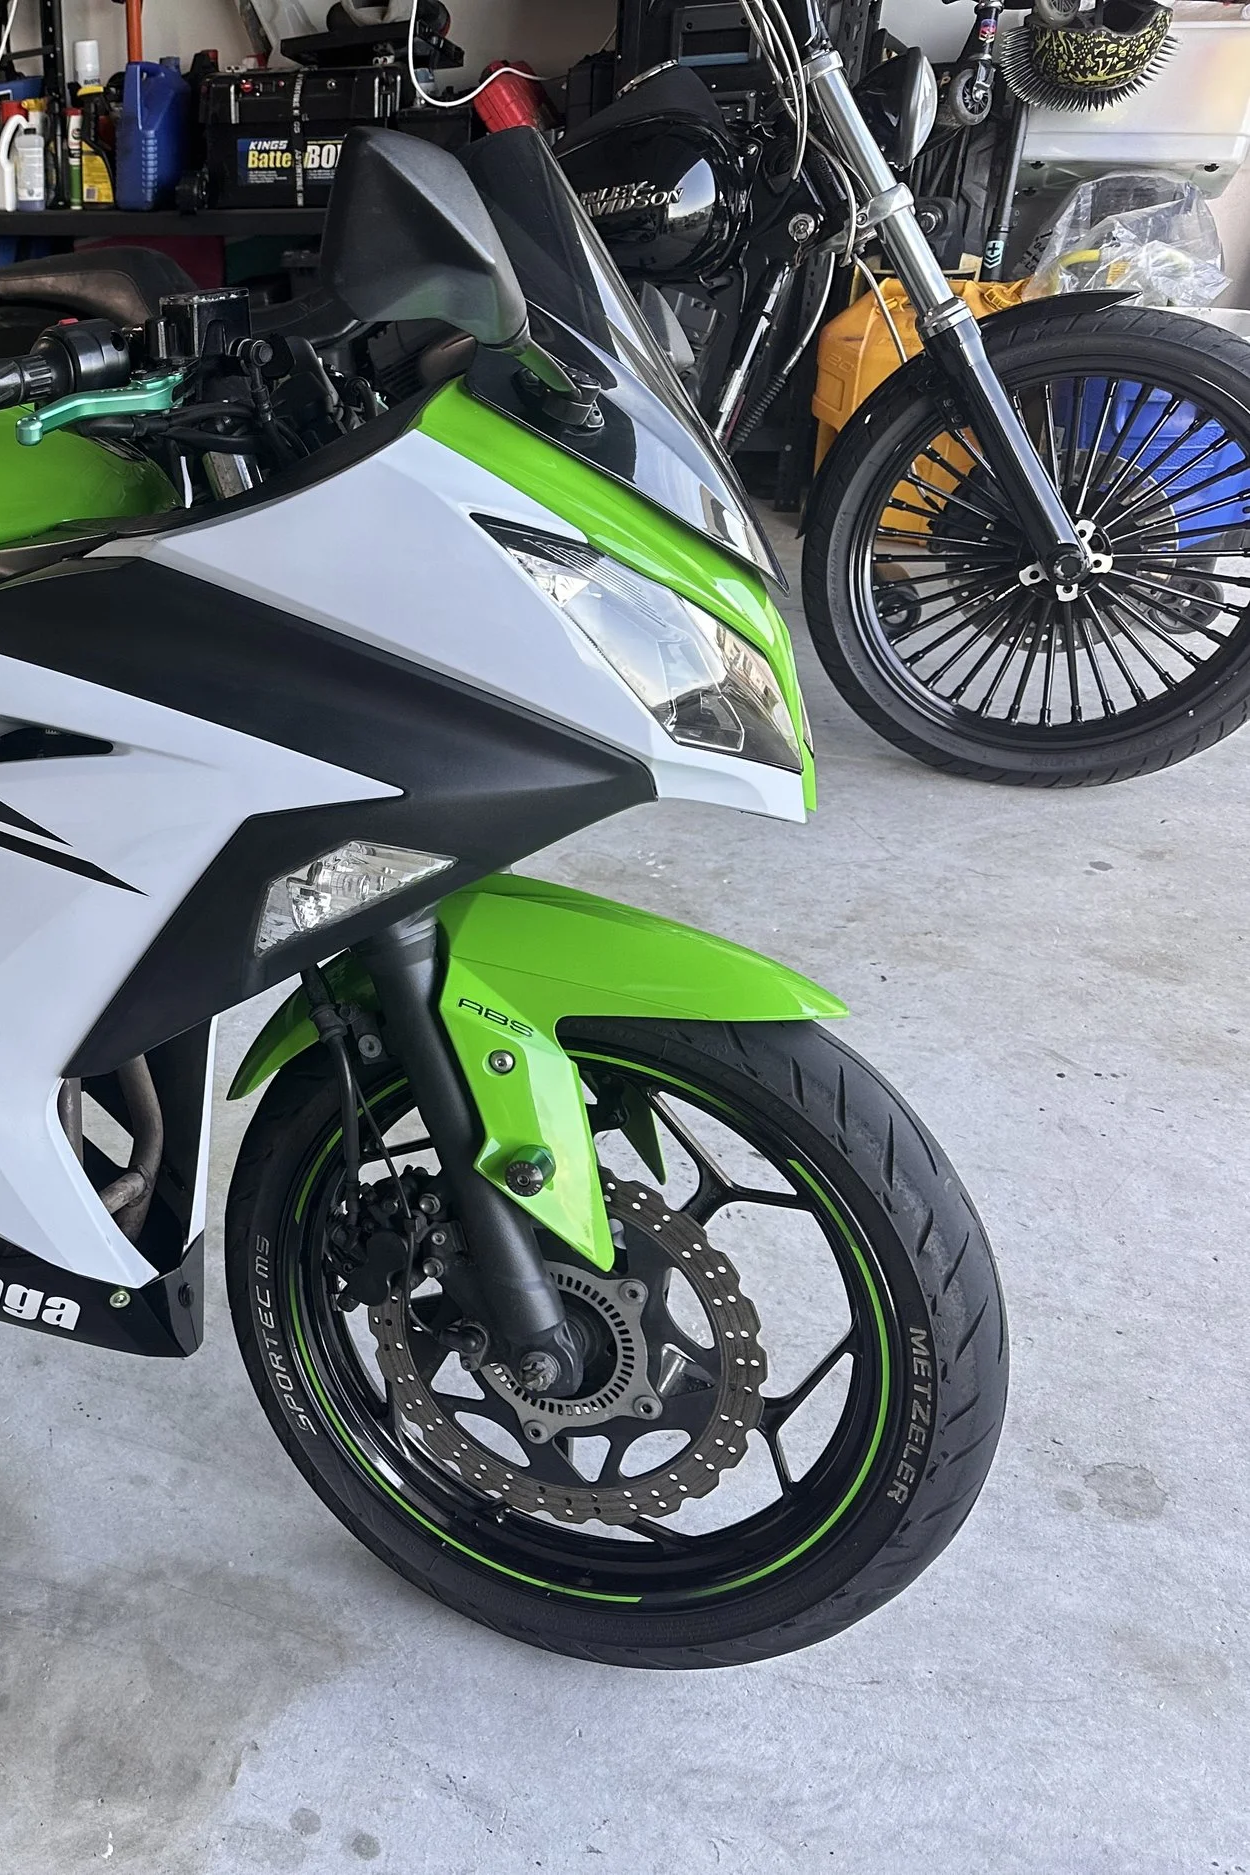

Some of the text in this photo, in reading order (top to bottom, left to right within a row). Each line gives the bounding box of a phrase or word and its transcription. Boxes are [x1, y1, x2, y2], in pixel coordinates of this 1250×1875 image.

[247, 151, 309, 169] Batte
[249, 140, 288, 150] KINGS
[582, 188, 684, 218] AVIDSON
[458, 998, 534, 1038] ABS
[255, 1285, 318, 1436] SPORTEC
[887, 1326, 934, 1505] METZELER
